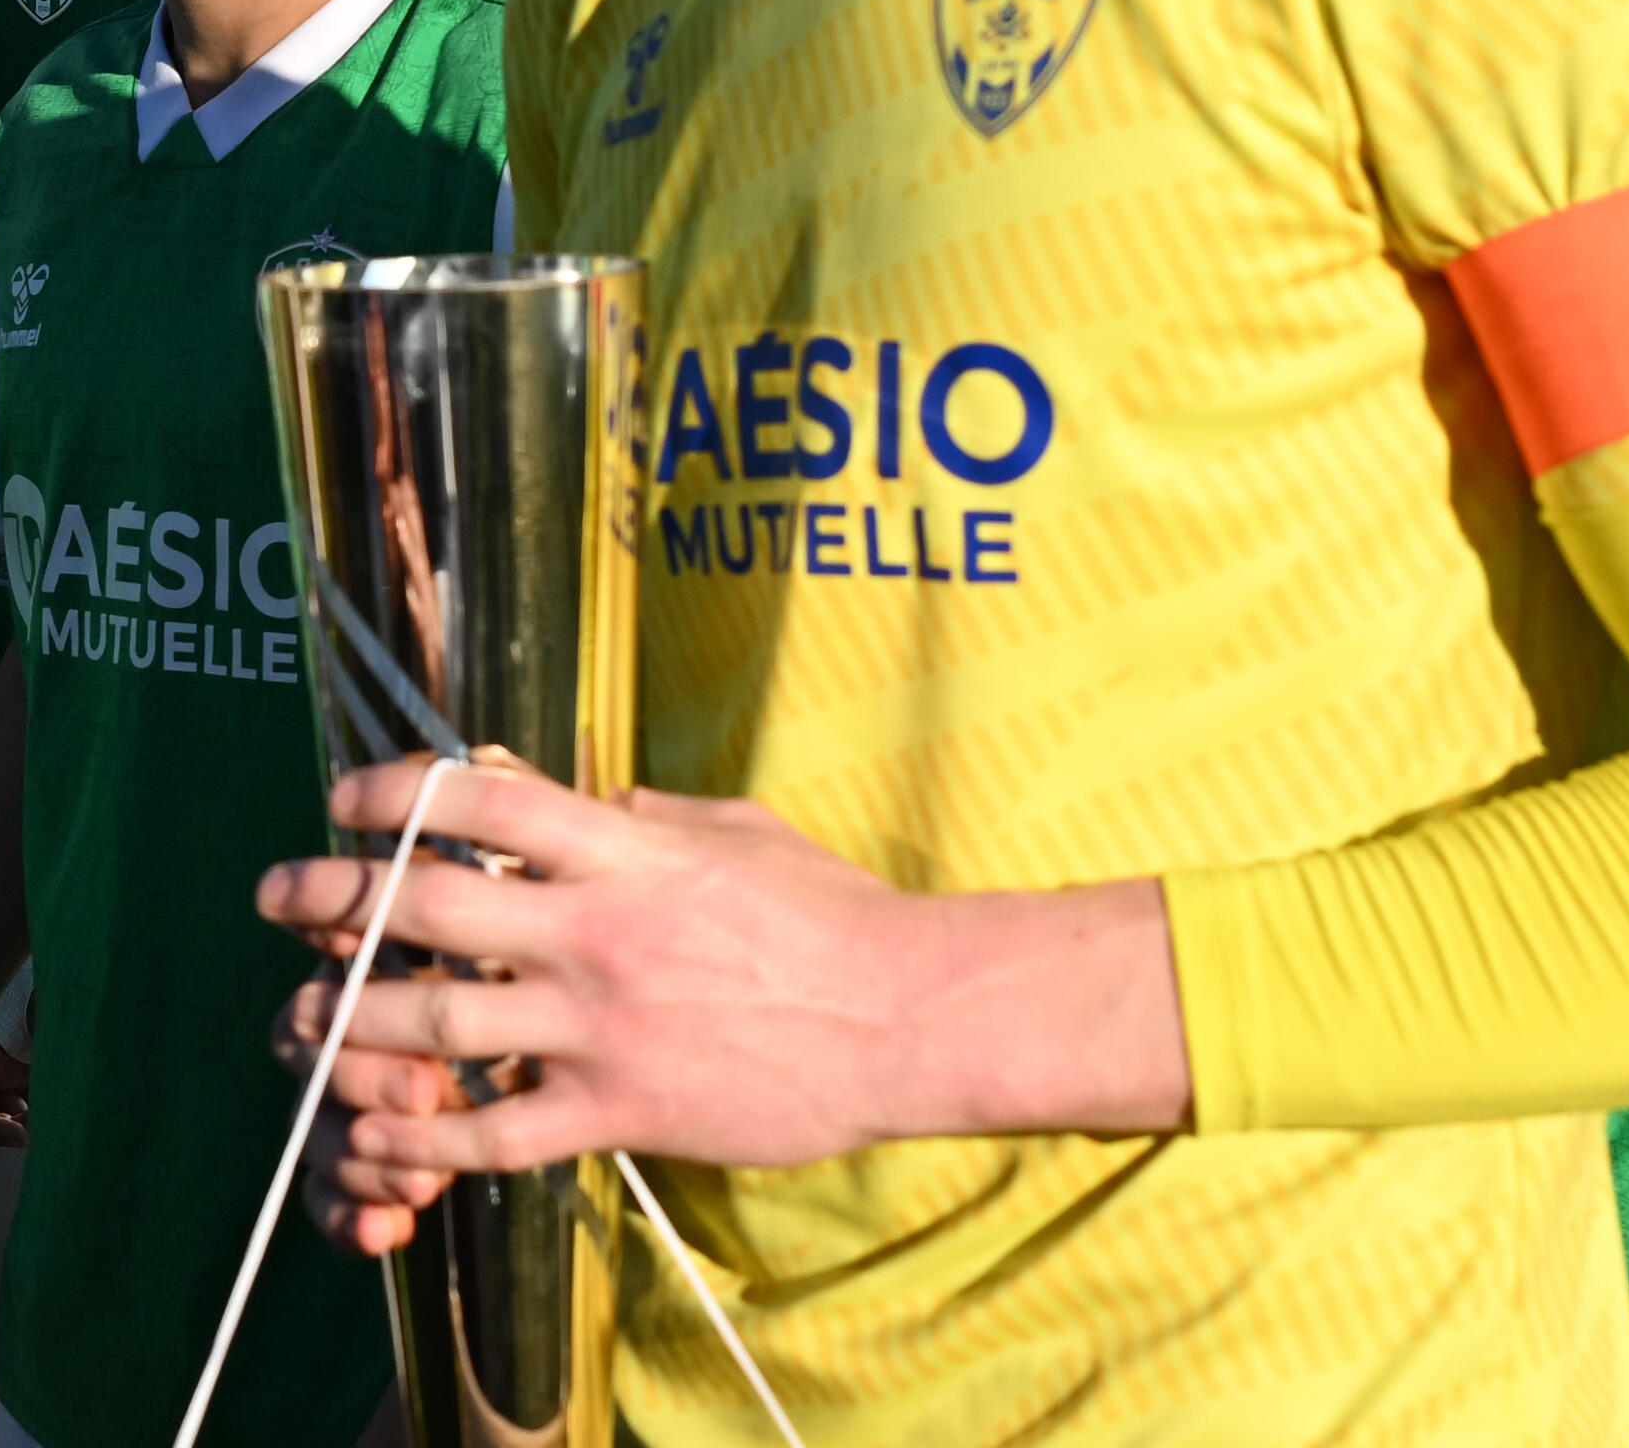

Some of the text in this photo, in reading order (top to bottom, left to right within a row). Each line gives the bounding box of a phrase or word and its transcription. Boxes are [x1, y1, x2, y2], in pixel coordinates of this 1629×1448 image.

[655, 330, 1055, 486] AÉSIO
[660, 502, 1019, 583] MUTELLE
[42, 607, 299, 684] MUTUELLE
